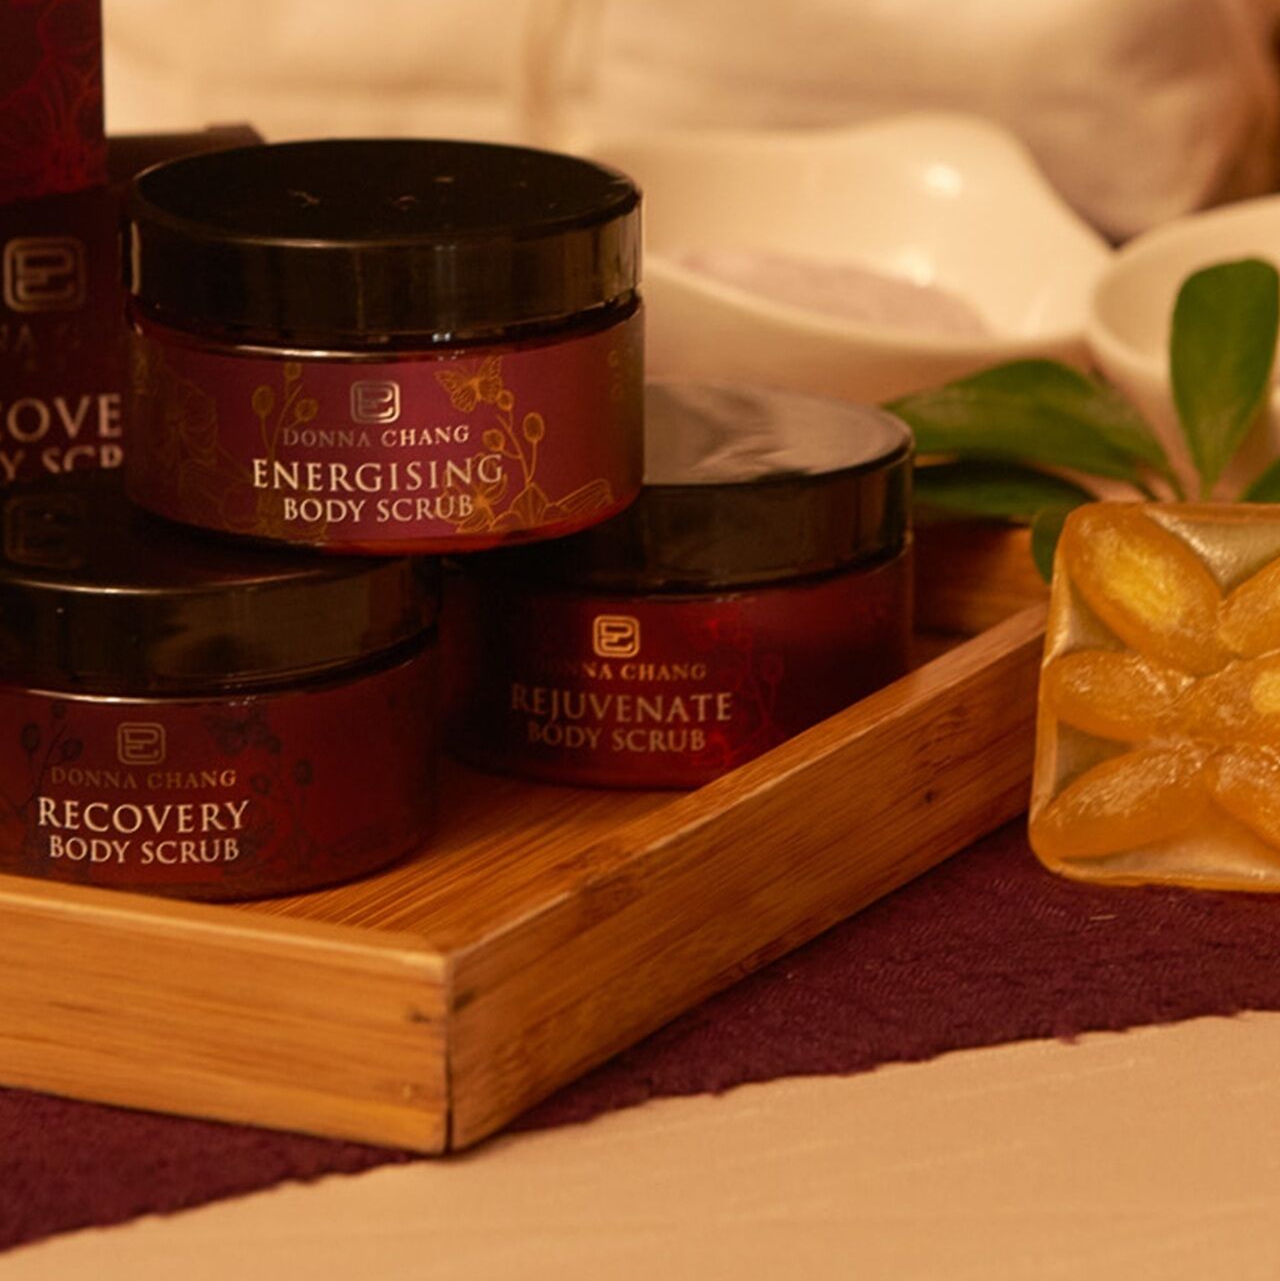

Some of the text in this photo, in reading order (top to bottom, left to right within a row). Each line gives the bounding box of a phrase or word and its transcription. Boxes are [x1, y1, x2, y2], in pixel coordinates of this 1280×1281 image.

[282, 423, 471, 449] DONNA CHANG
[251, 452, 505, 493] ENERGISING
[282, 493, 474, 524] BODY SCRUB
[621, 661, 708, 682] CHANG
[511, 683, 734, 725] REJUVENATE
[528, 721, 707, 753] BODY SCRUB
[49, 765, 237, 790] DONNA CHANG
[36, 795, 251, 834] RECOVERY
[48, 833, 241, 865] BODY SCRUB
